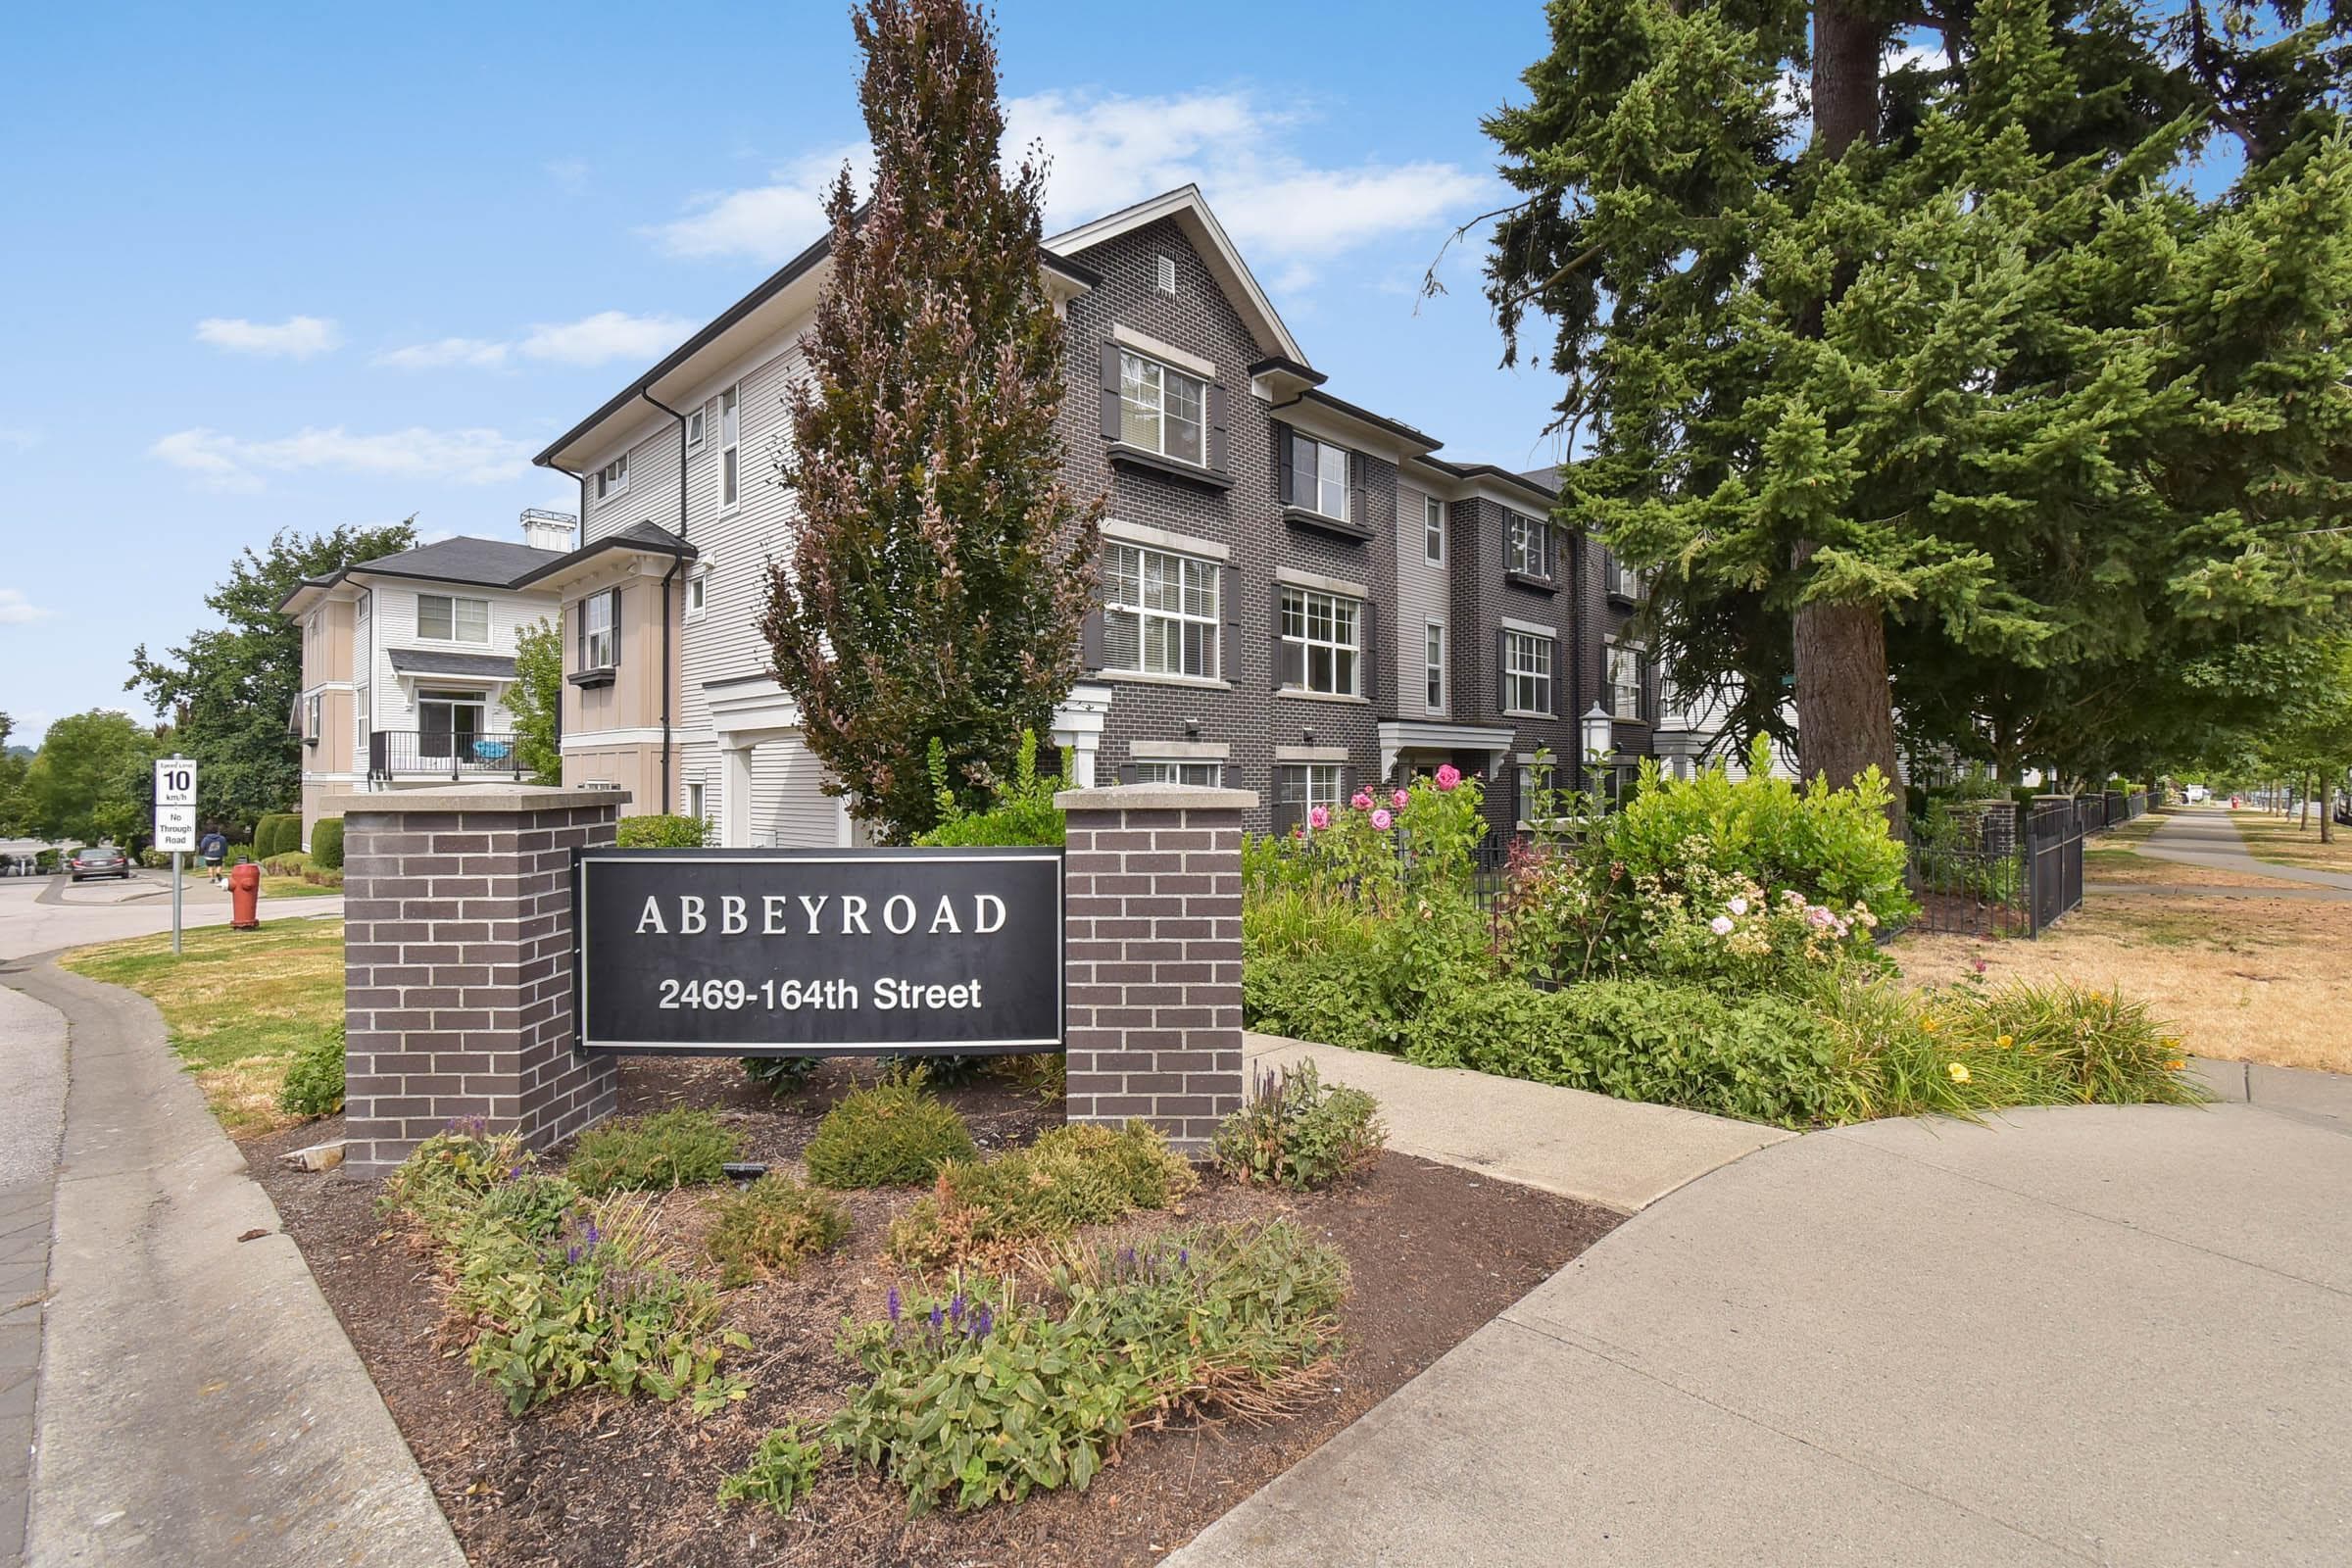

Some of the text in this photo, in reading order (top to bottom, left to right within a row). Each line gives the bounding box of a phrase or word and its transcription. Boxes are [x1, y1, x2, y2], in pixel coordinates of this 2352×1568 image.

[163, 770, 190, 791] 10
[160, 824, 192, 833] Through
[165, 835, 186, 844] Road
[635, 894, 1006, 935] ABBEYROAD
[659, 977, 982, 1010] 2469-164th Street
